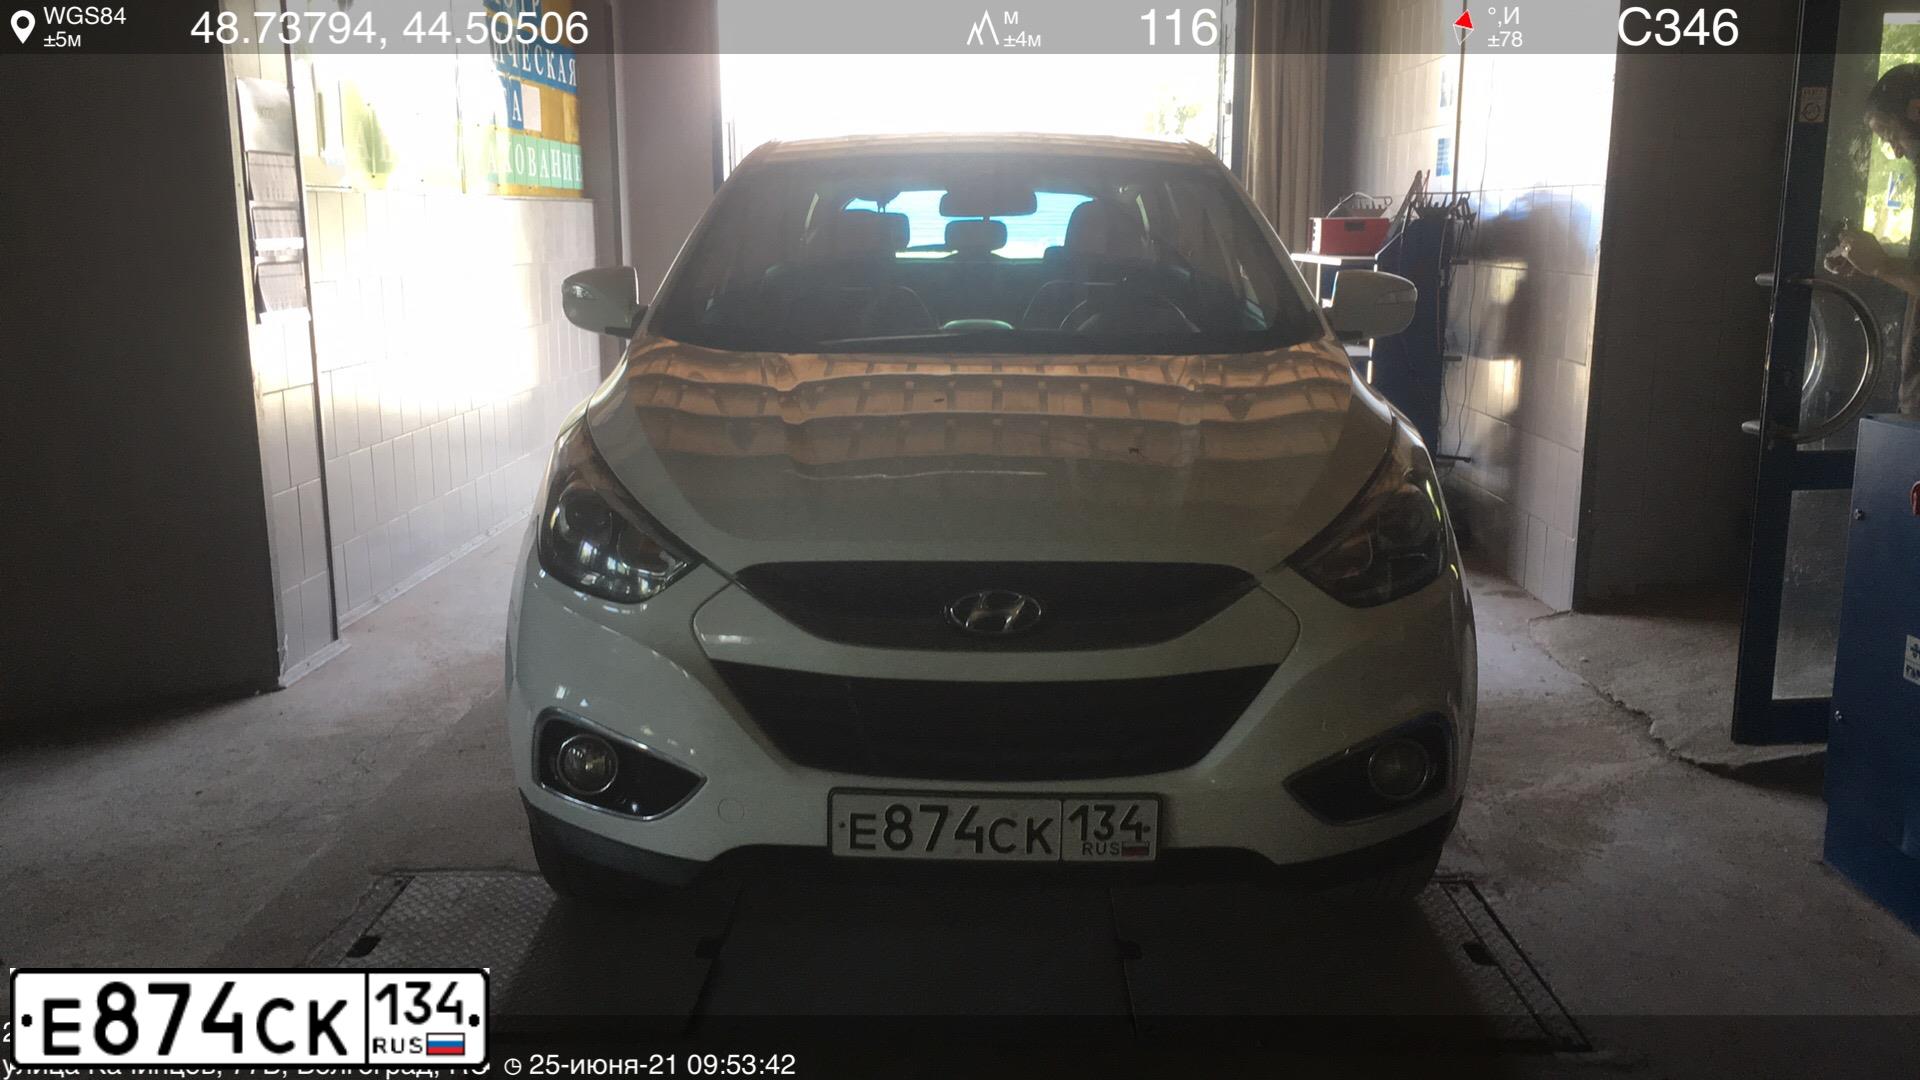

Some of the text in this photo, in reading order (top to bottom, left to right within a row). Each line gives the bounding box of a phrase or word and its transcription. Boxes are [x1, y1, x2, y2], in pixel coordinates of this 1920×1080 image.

[849, 803, 1144, 855] Е874СК 134
[1082, 842, 1120, 856] RUS
